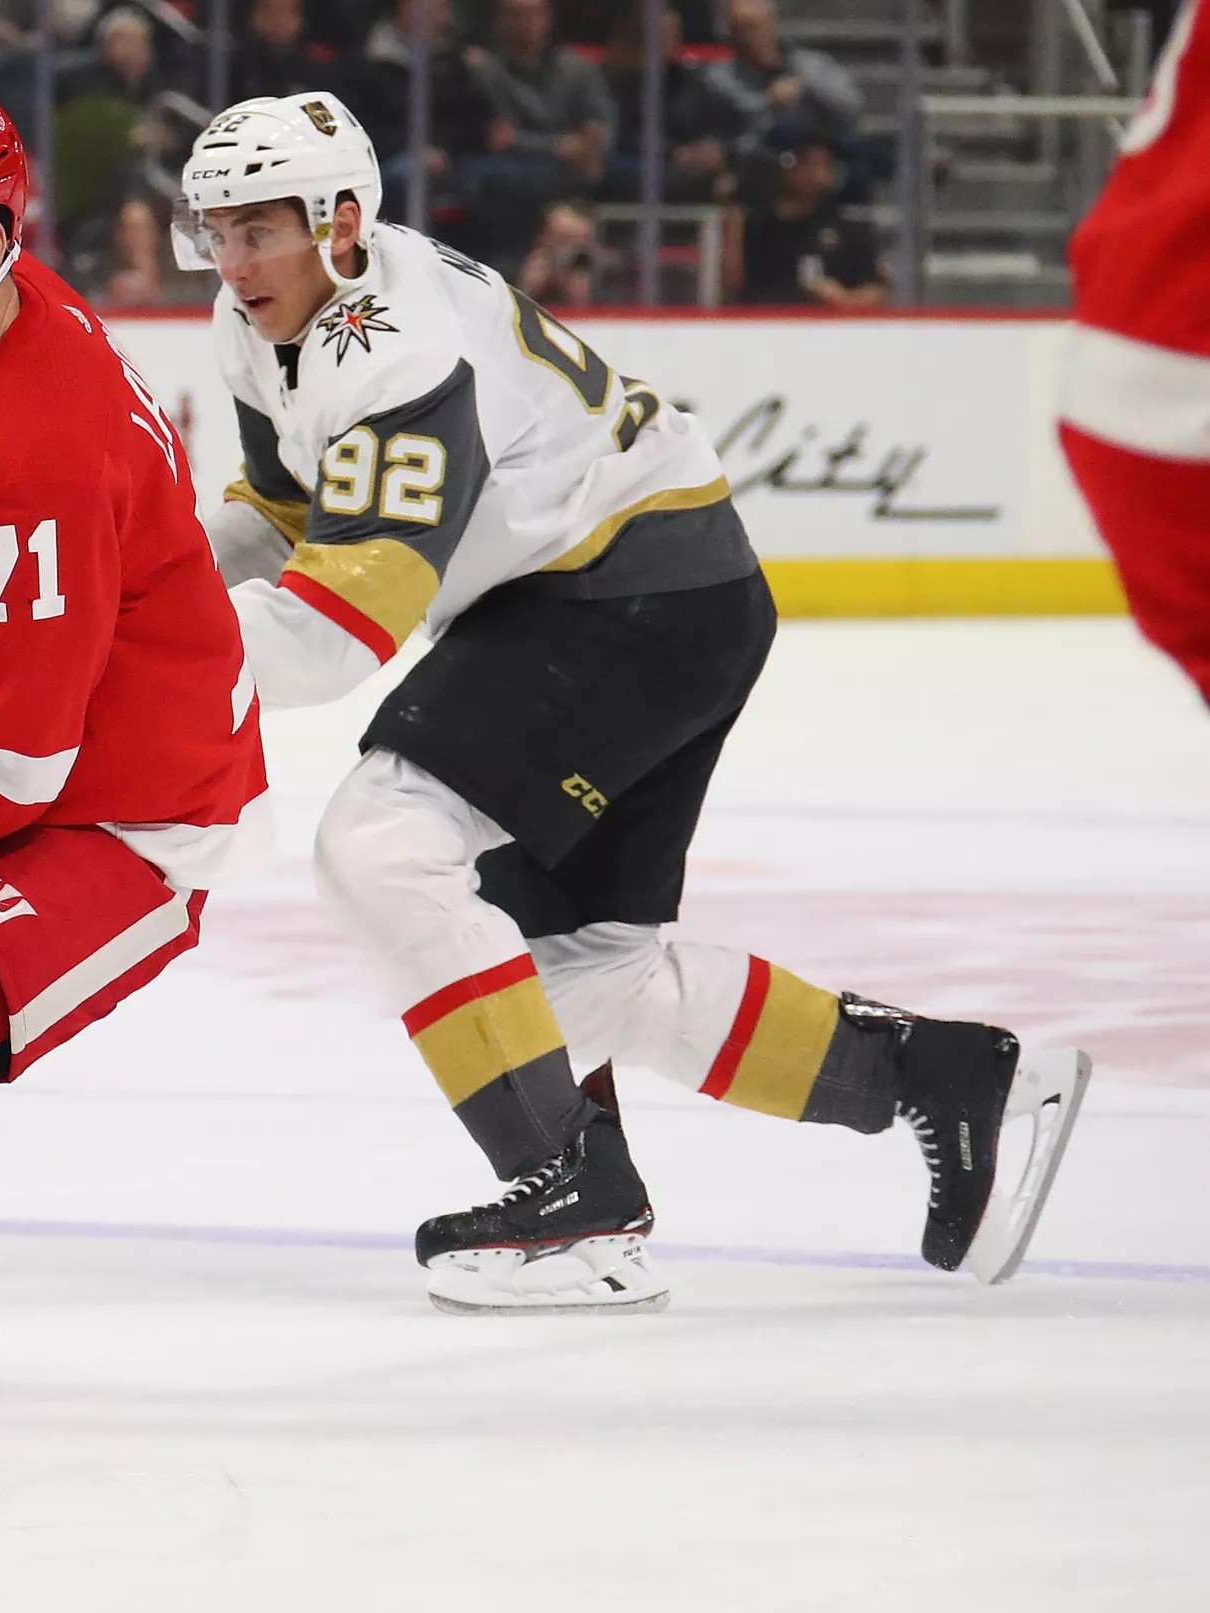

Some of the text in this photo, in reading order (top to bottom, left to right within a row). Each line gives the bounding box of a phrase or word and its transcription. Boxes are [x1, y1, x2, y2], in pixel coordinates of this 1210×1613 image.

[191, 168, 232, 180] CCM
[318, 425, 447, 527] 92
[561, 772, 608, 820] CC
